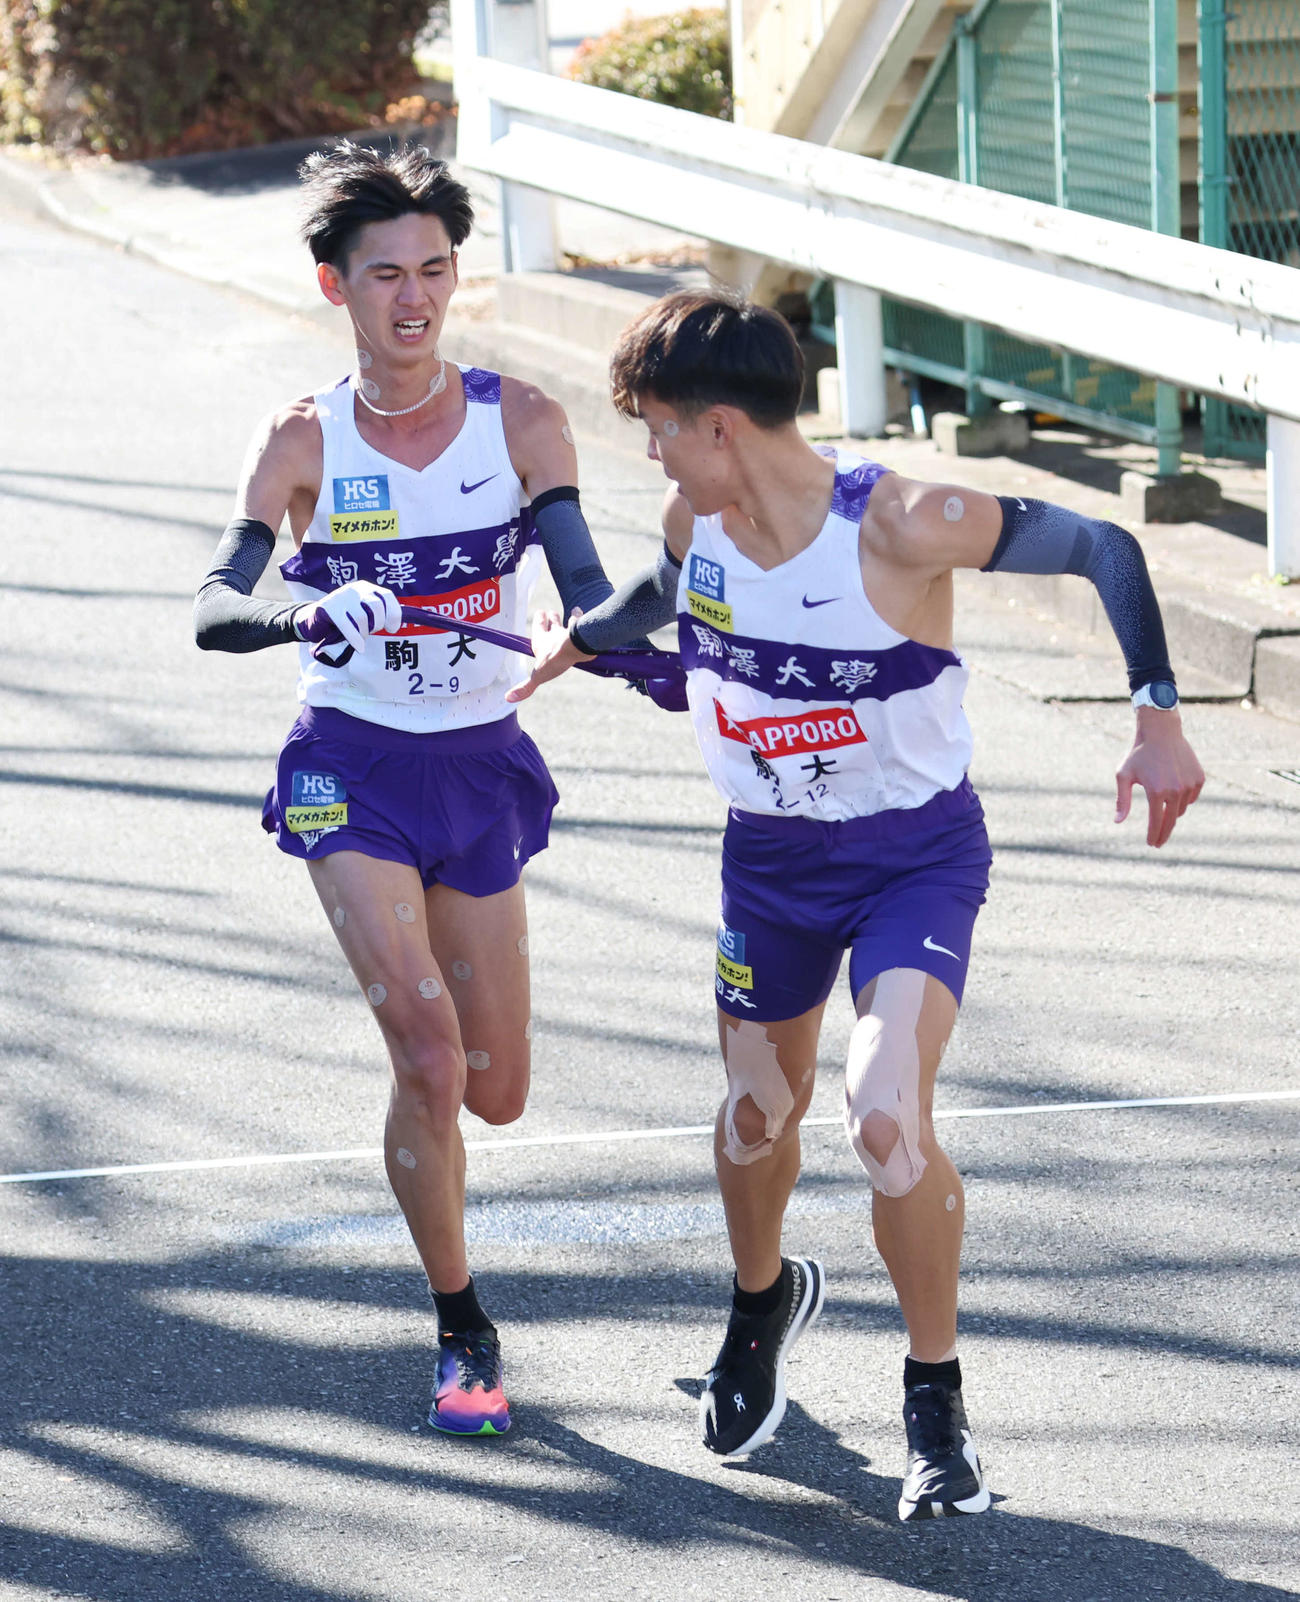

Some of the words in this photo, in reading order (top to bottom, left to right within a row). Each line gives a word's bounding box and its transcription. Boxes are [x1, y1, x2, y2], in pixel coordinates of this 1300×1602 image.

[343, 479, 379, 500] HRS
[332, 518, 395, 533] マイメガホン!
[696, 559, 720, 587] HRS
[302, 775, 336, 794] HRS
